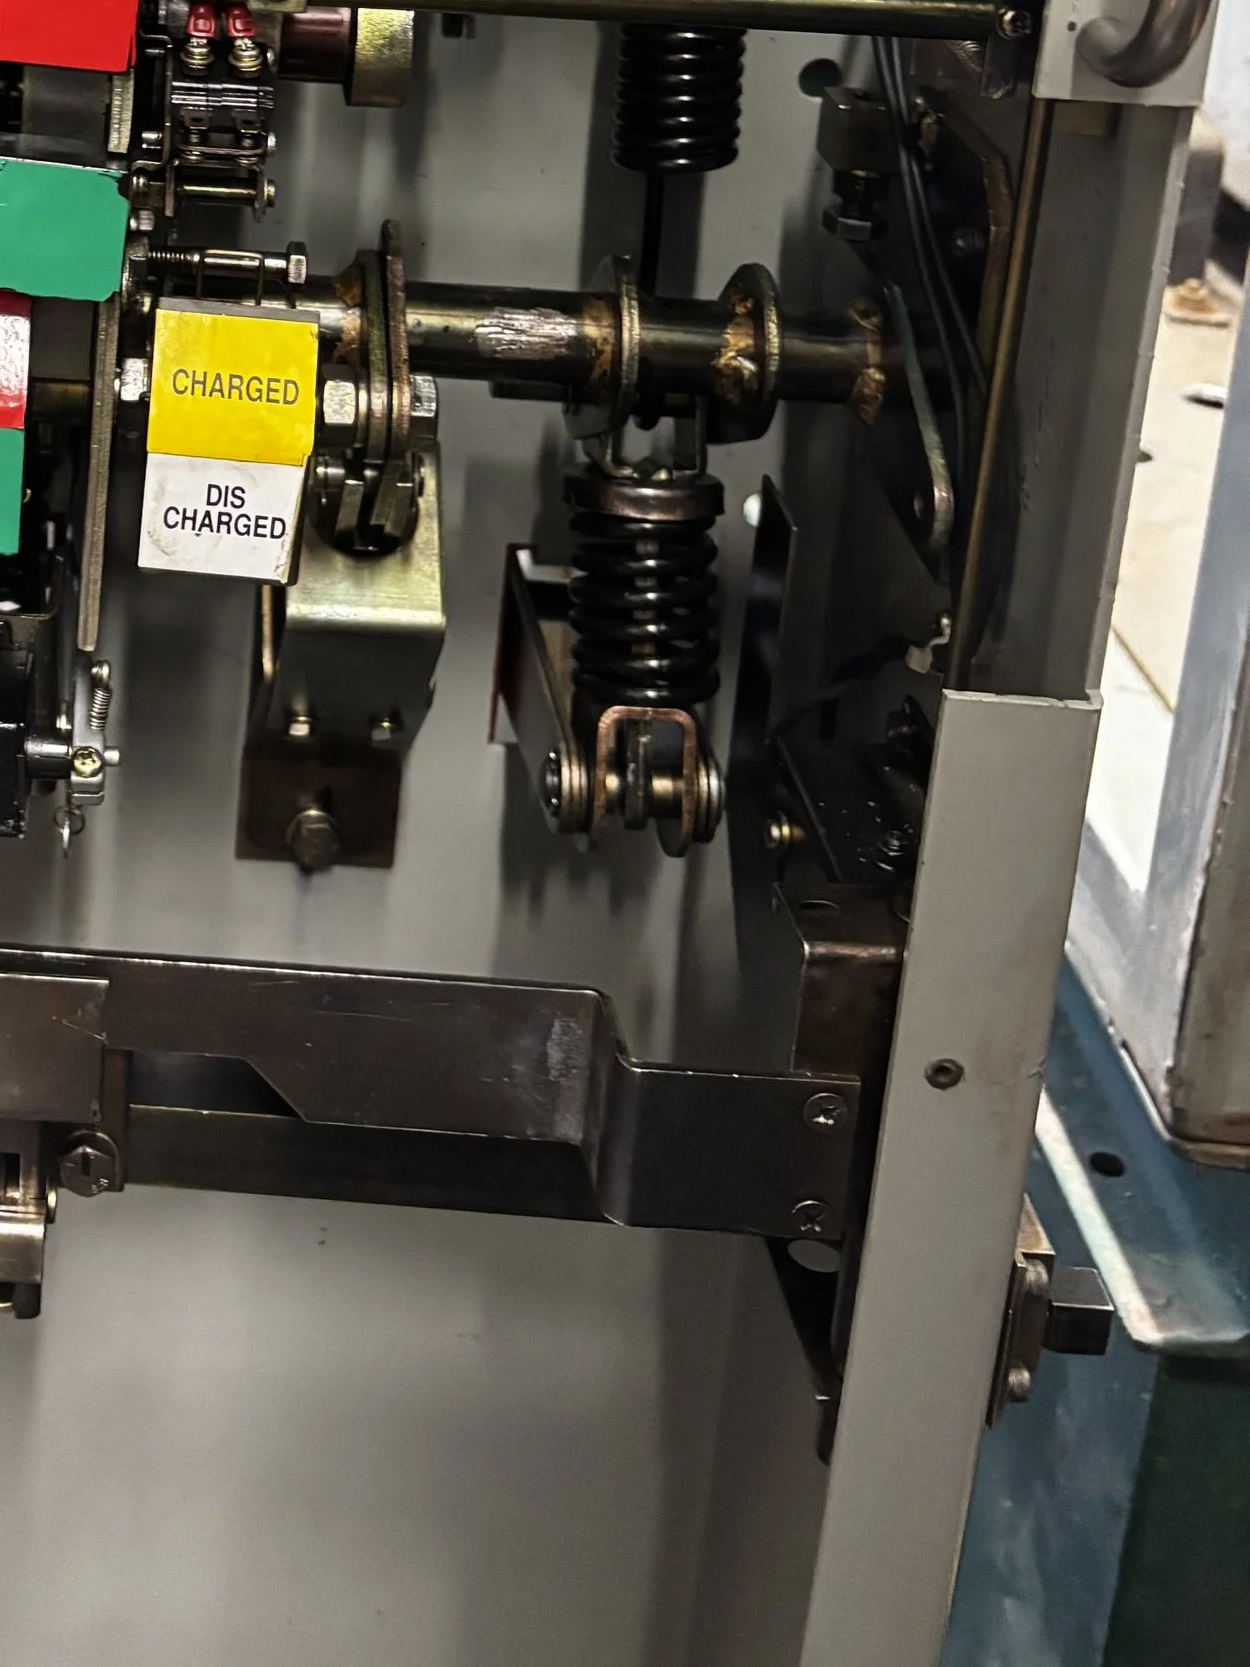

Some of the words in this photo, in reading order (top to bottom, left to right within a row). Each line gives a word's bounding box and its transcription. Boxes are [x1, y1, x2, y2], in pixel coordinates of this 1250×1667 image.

[171, 368, 300, 406] CHARGED
[206, 483, 247, 510] DIS
[163, 506, 287, 540] CHARGED
